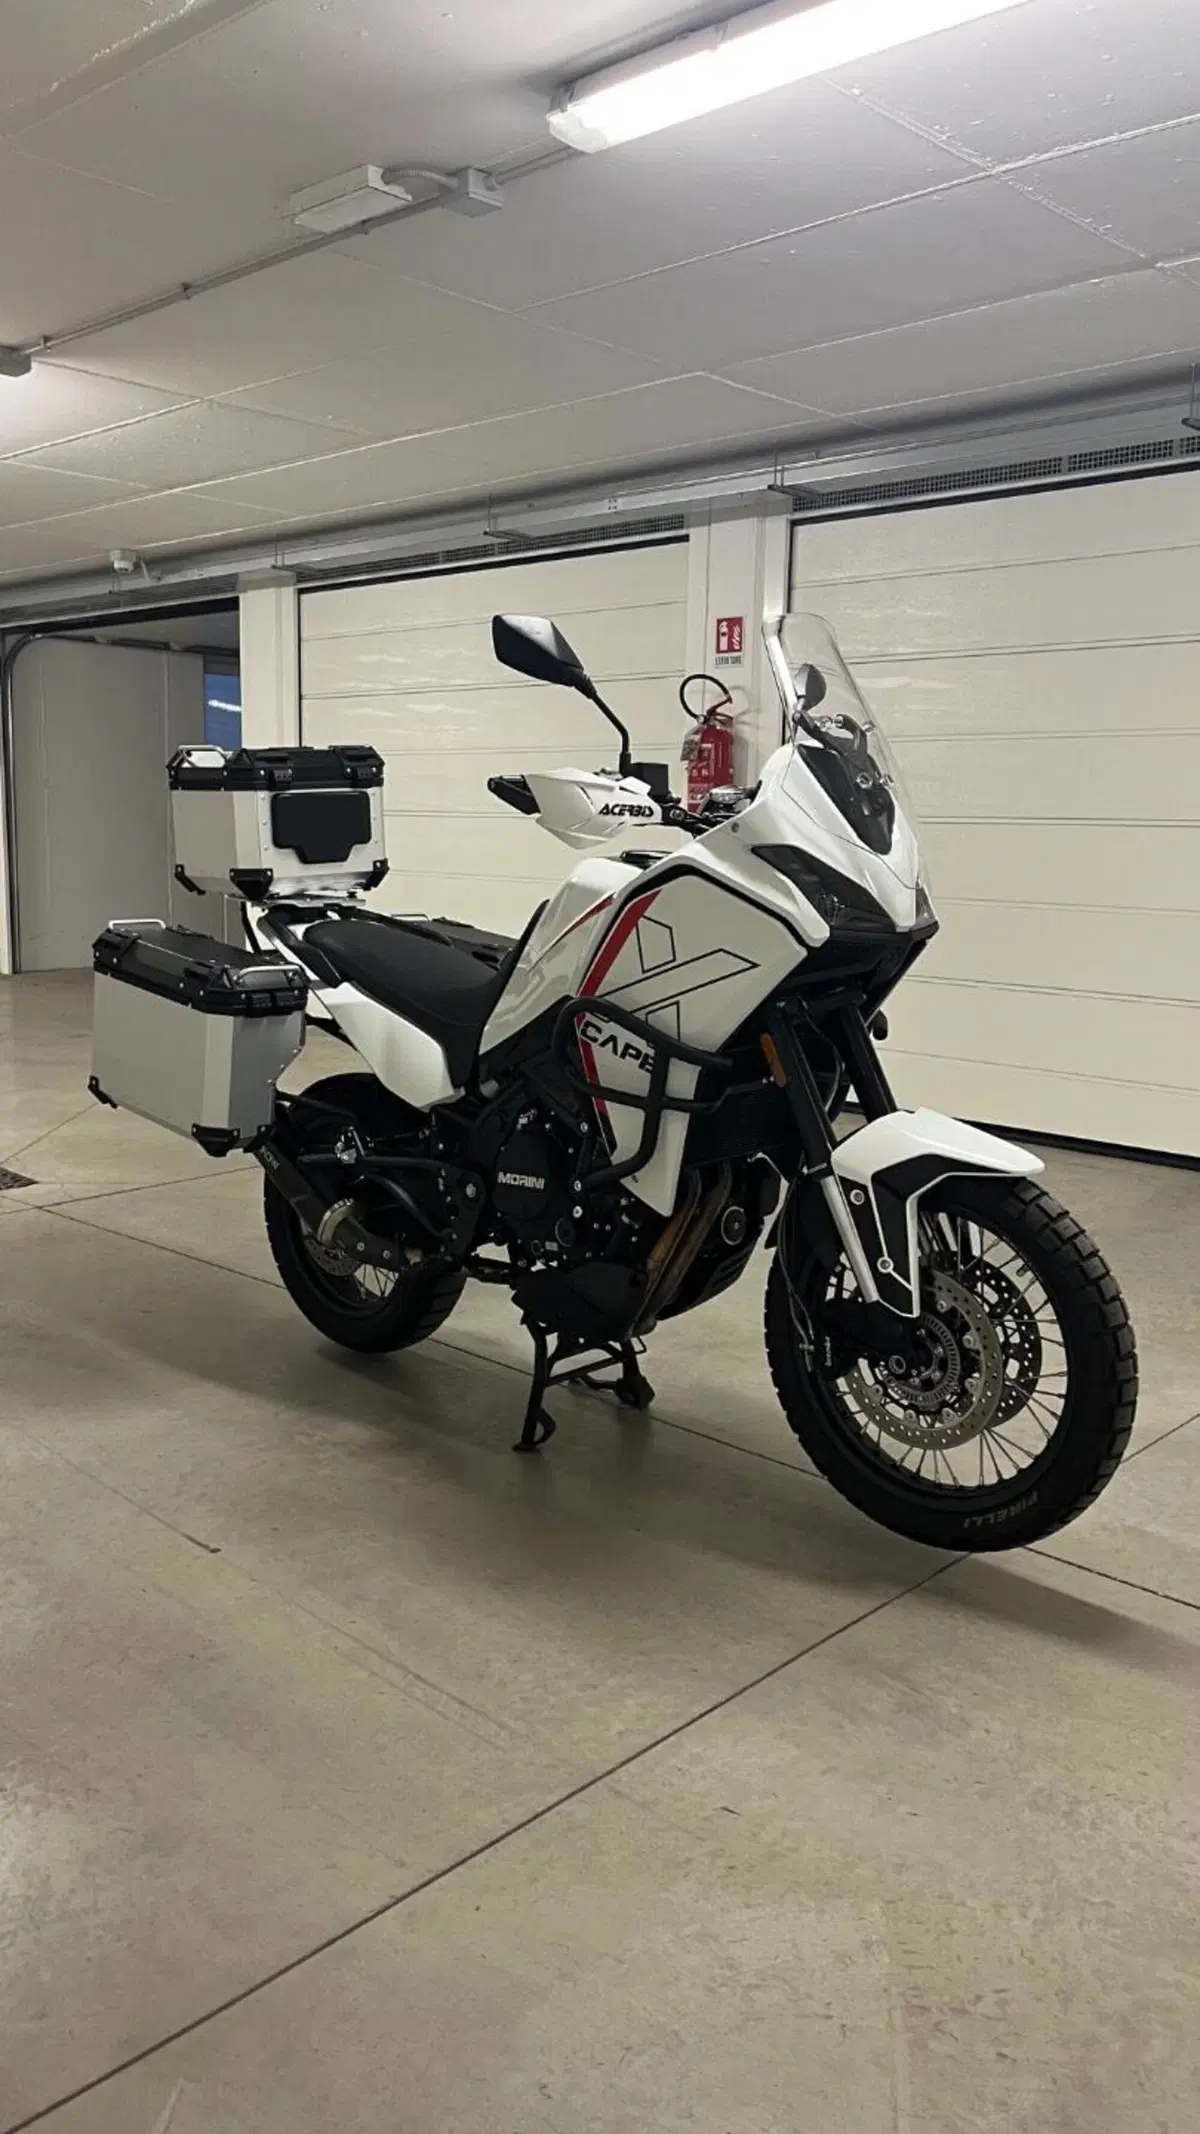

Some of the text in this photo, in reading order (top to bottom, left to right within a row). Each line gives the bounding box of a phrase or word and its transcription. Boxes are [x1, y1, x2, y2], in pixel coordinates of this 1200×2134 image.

[598, 803, 654, 818] ACERBIS
[497, 1171, 546, 1190] MORINI
[962, 1491, 1039, 1529] PIRELLI
